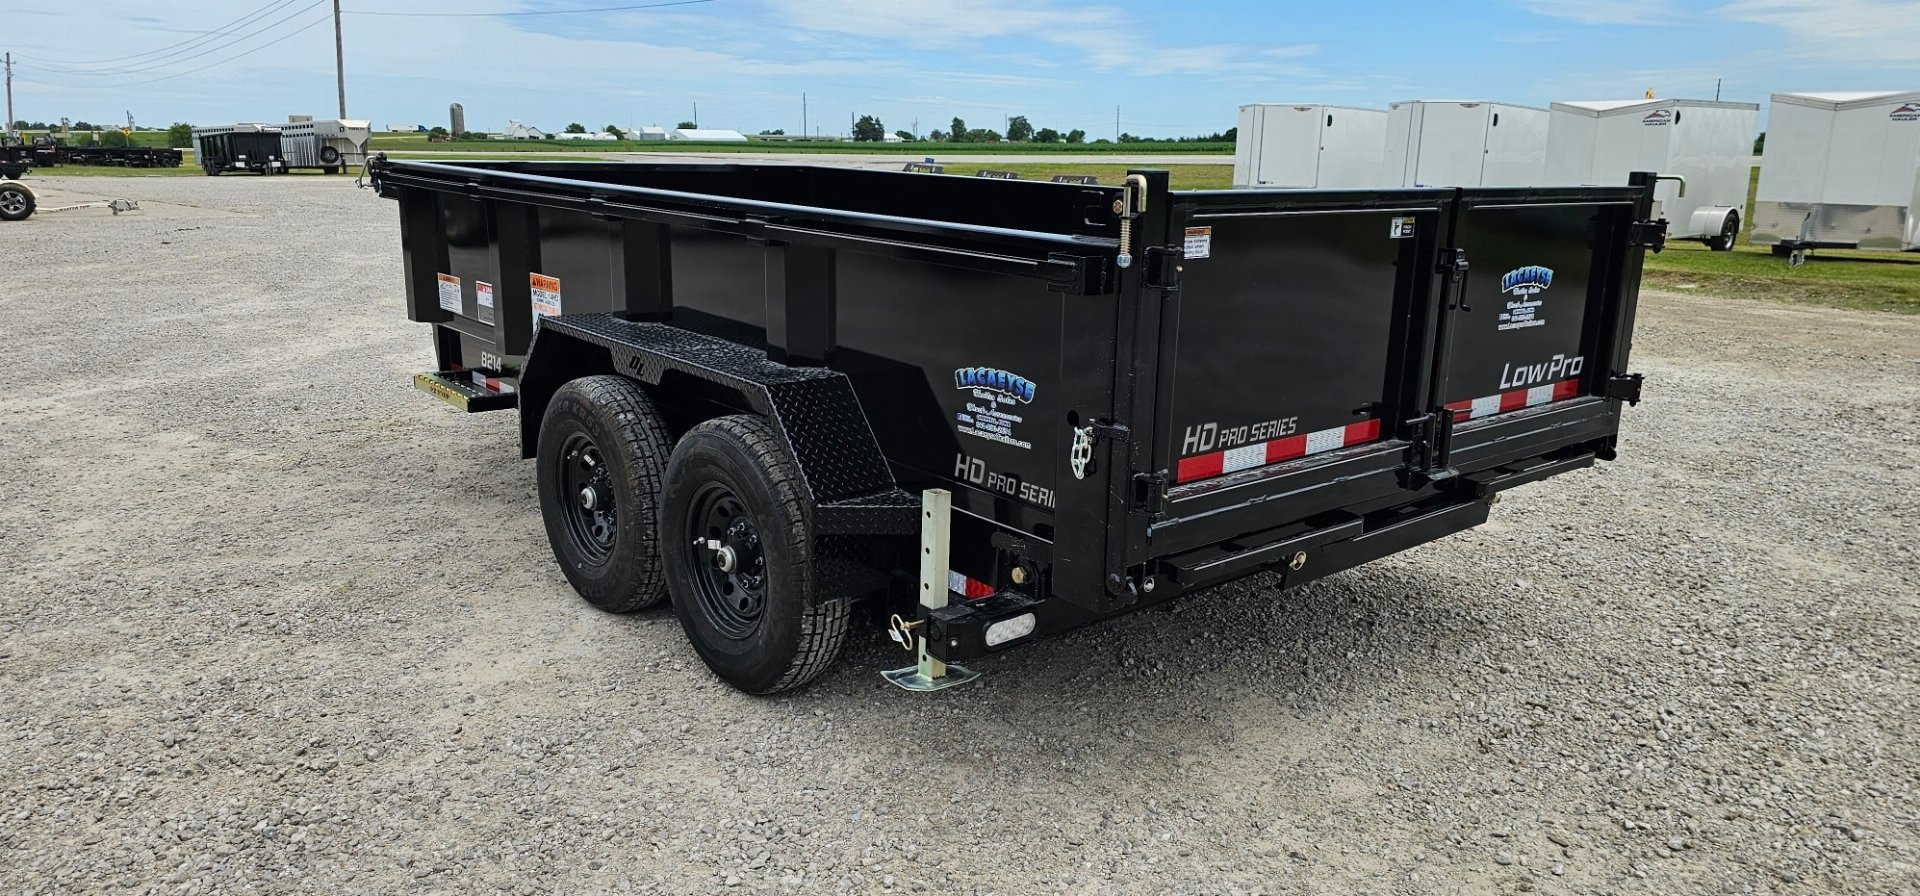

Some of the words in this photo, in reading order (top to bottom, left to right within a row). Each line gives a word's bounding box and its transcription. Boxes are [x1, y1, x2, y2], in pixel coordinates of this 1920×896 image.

[481, 351, 502, 373] 8214
[954, 366, 1037, 405] LACAEYSE
[1182, 421, 1218, 455] HD
[1218, 425, 1249, 449] PRO
[1249, 416, 1299, 443] SERIES
[954, 452, 986, 484] HD
[987, 471, 1017, 496] PRO
[1019, 481, 1055, 509] SERI
